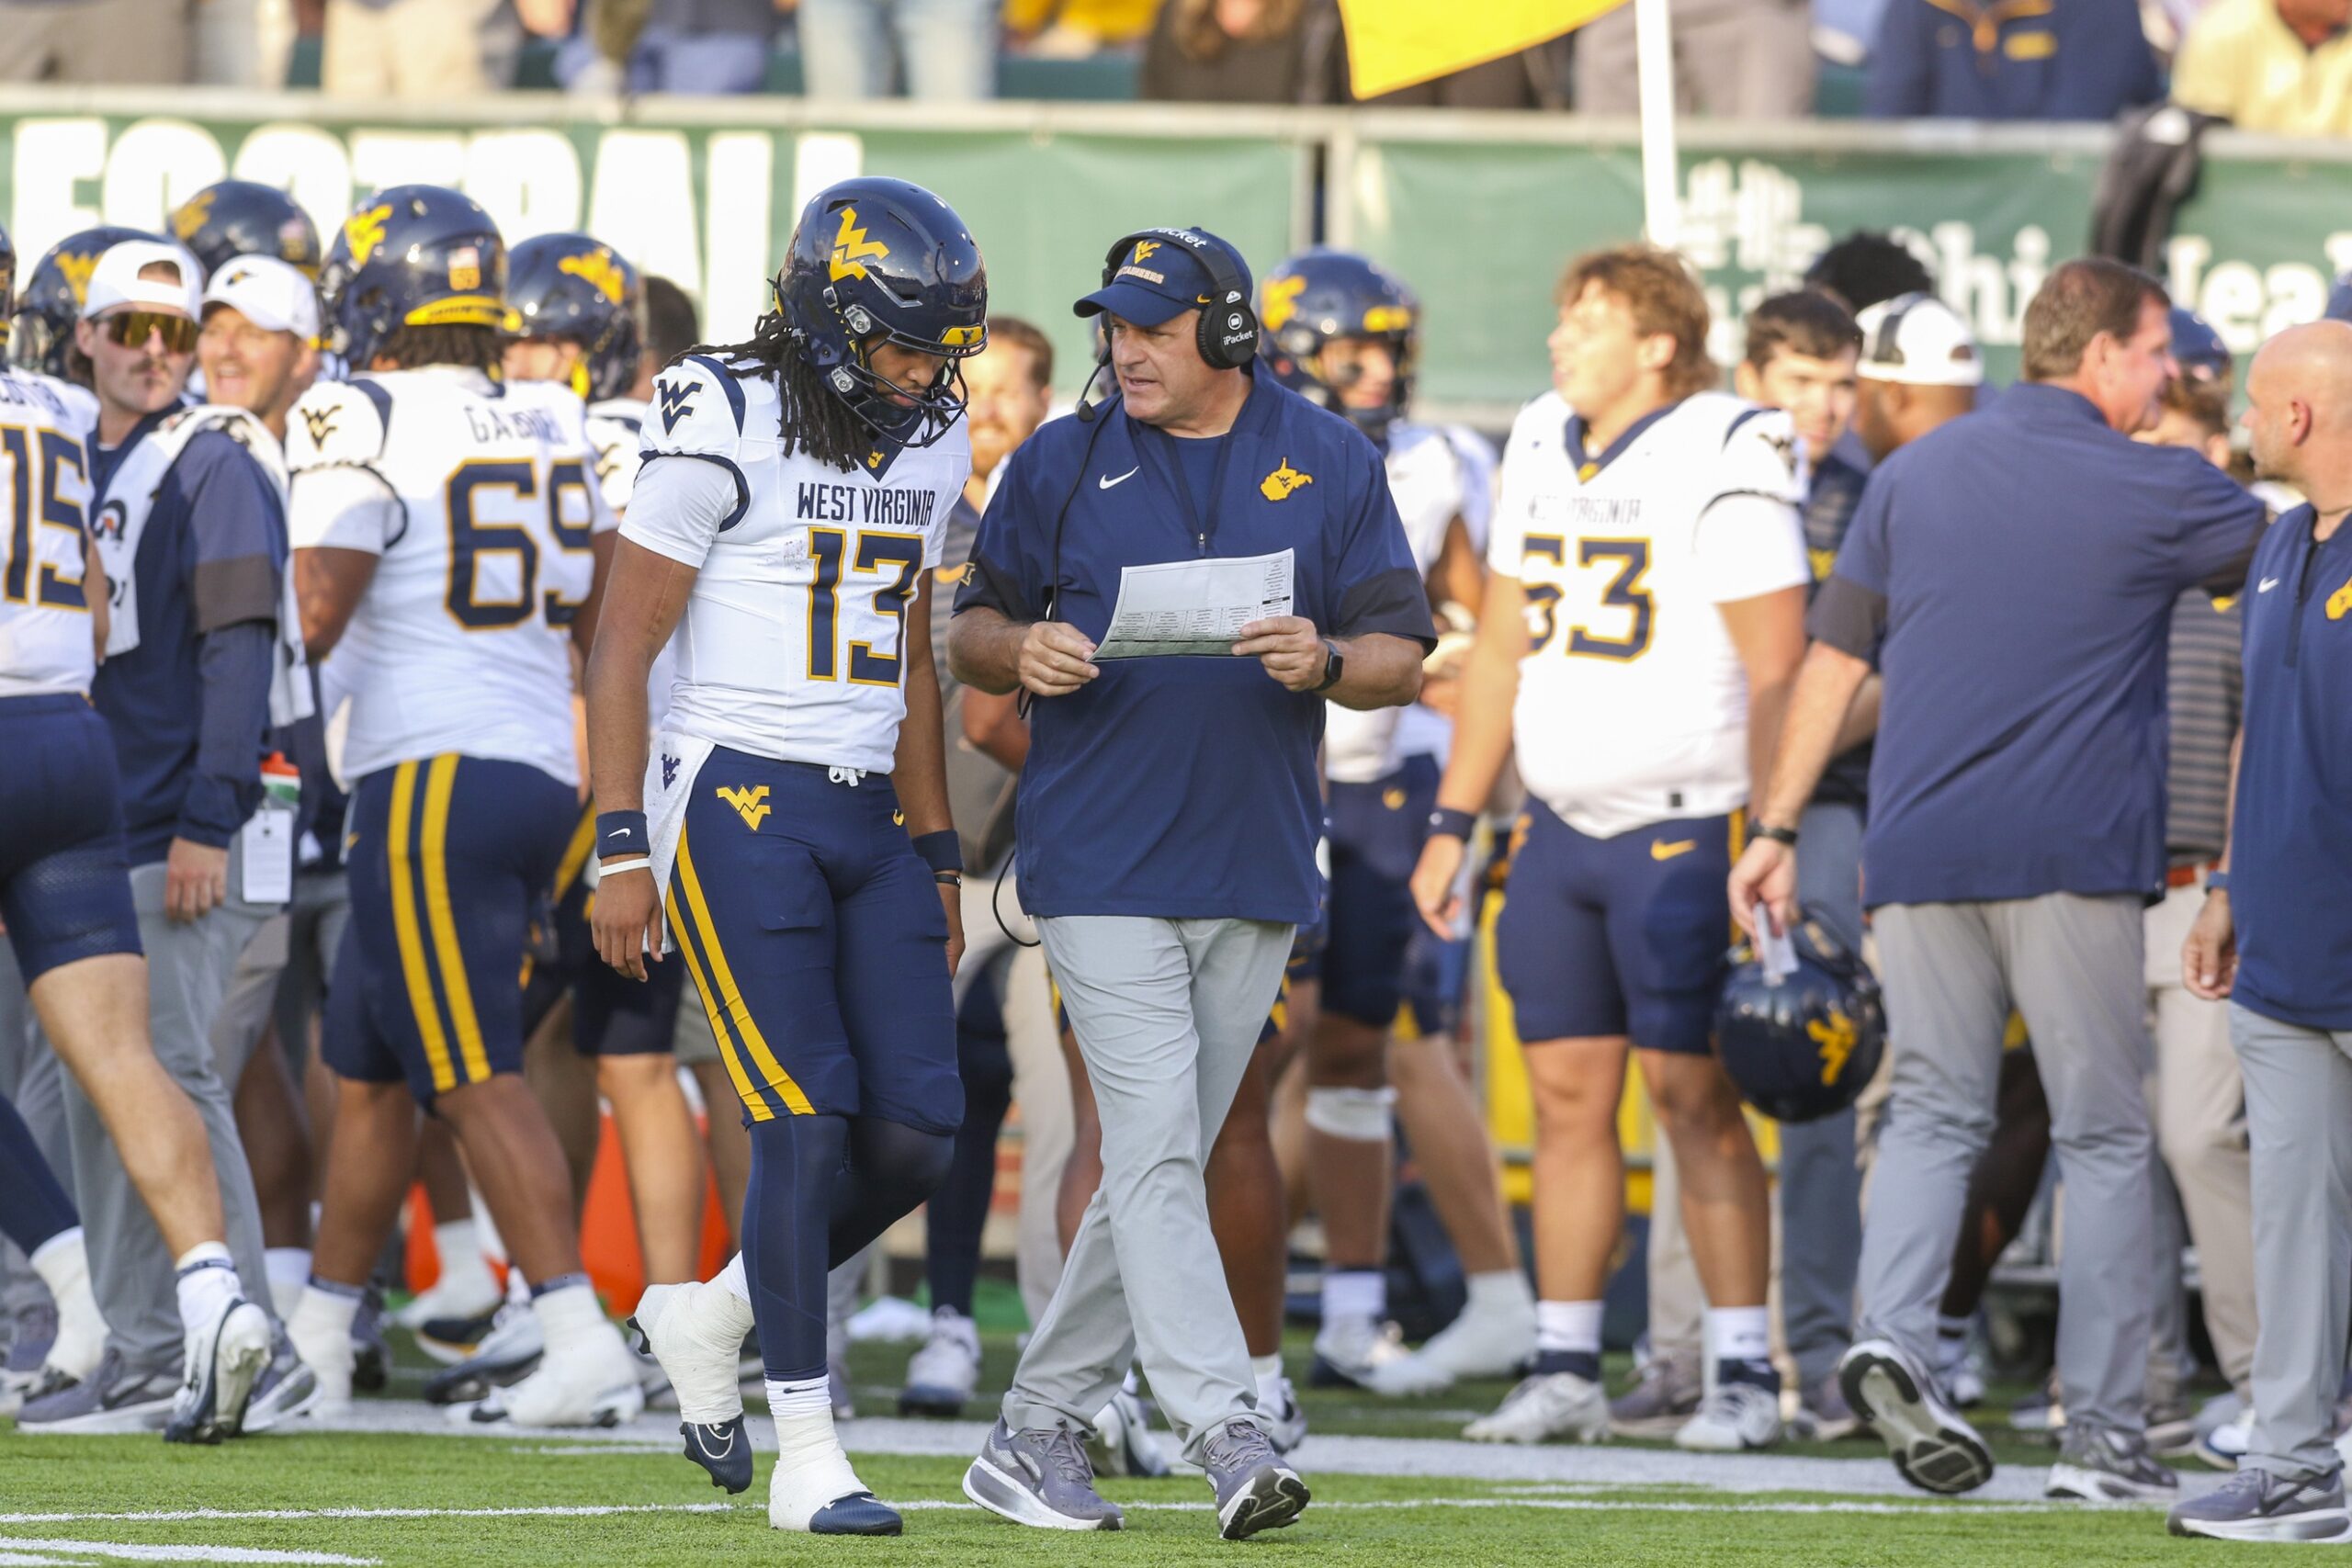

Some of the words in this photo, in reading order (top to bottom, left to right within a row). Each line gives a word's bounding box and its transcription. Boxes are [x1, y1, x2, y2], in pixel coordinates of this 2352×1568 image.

[1223, 330, 1253, 346] iPacket
[0, 423, 90, 613] 15
[445, 457, 594, 632] 69
[797, 482, 855, 521] WEST
[861, 488, 936, 526] VIRGINIA
[807, 525, 924, 688] 13
